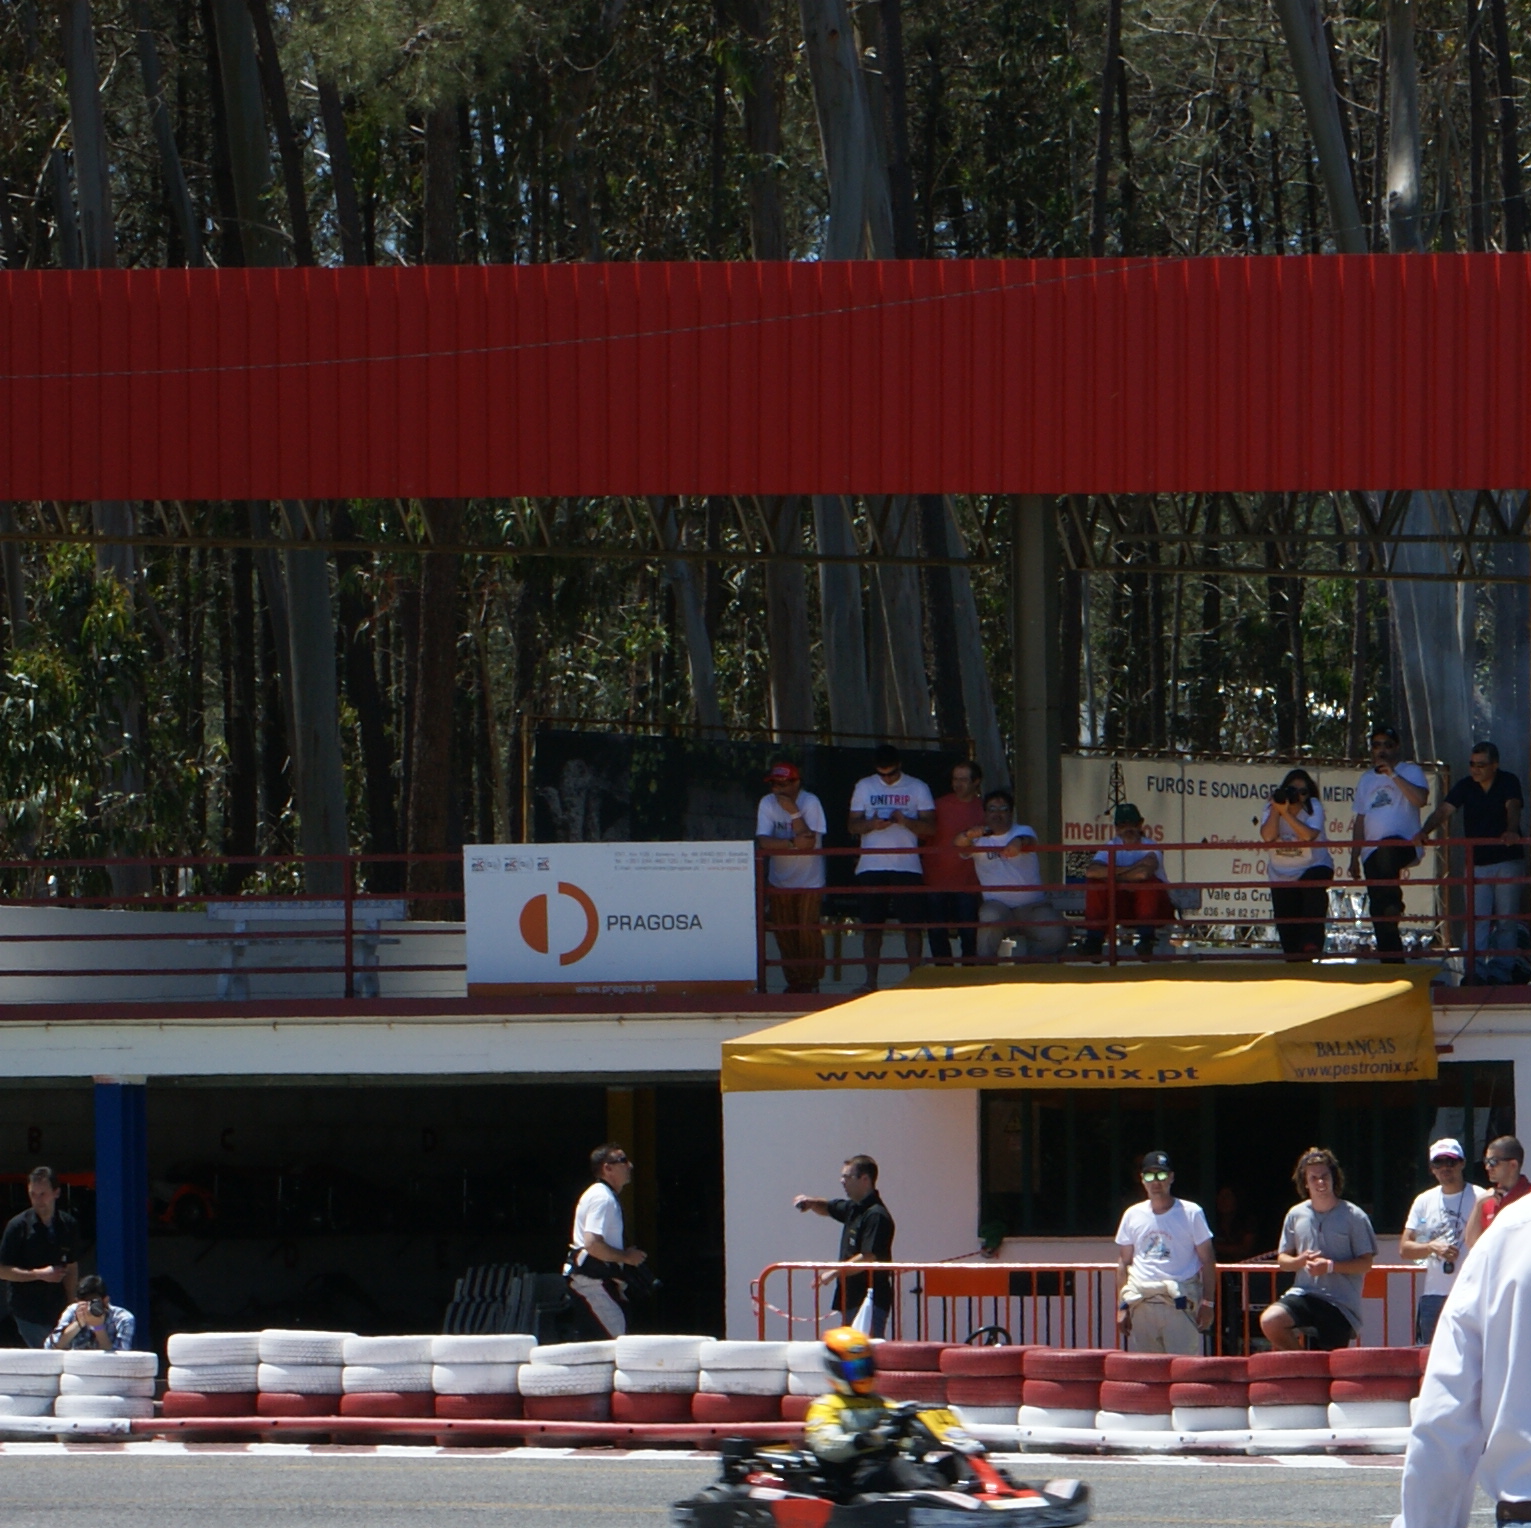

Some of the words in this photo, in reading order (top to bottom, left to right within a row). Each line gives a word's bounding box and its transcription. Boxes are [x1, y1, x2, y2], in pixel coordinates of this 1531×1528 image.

[1146, 775, 1195, 796] FUROS
[1198, 779, 1208, 797] E
[1211, 781, 1279, 800] SONDAGE
[870, 794, 911, 806] UNITRIP
[1207, 888, 1230, 902] Vale
[1233, 888, 1248, 901] da
[606, 914, 703, 931] PRAGOSA
[815, 1065, 1200, 1083] www.pestronix.pt
[27, 1126, 42, 1153] B
[220, 1127, 235, 1152] C
[422, 1127, 438, 1152] D
